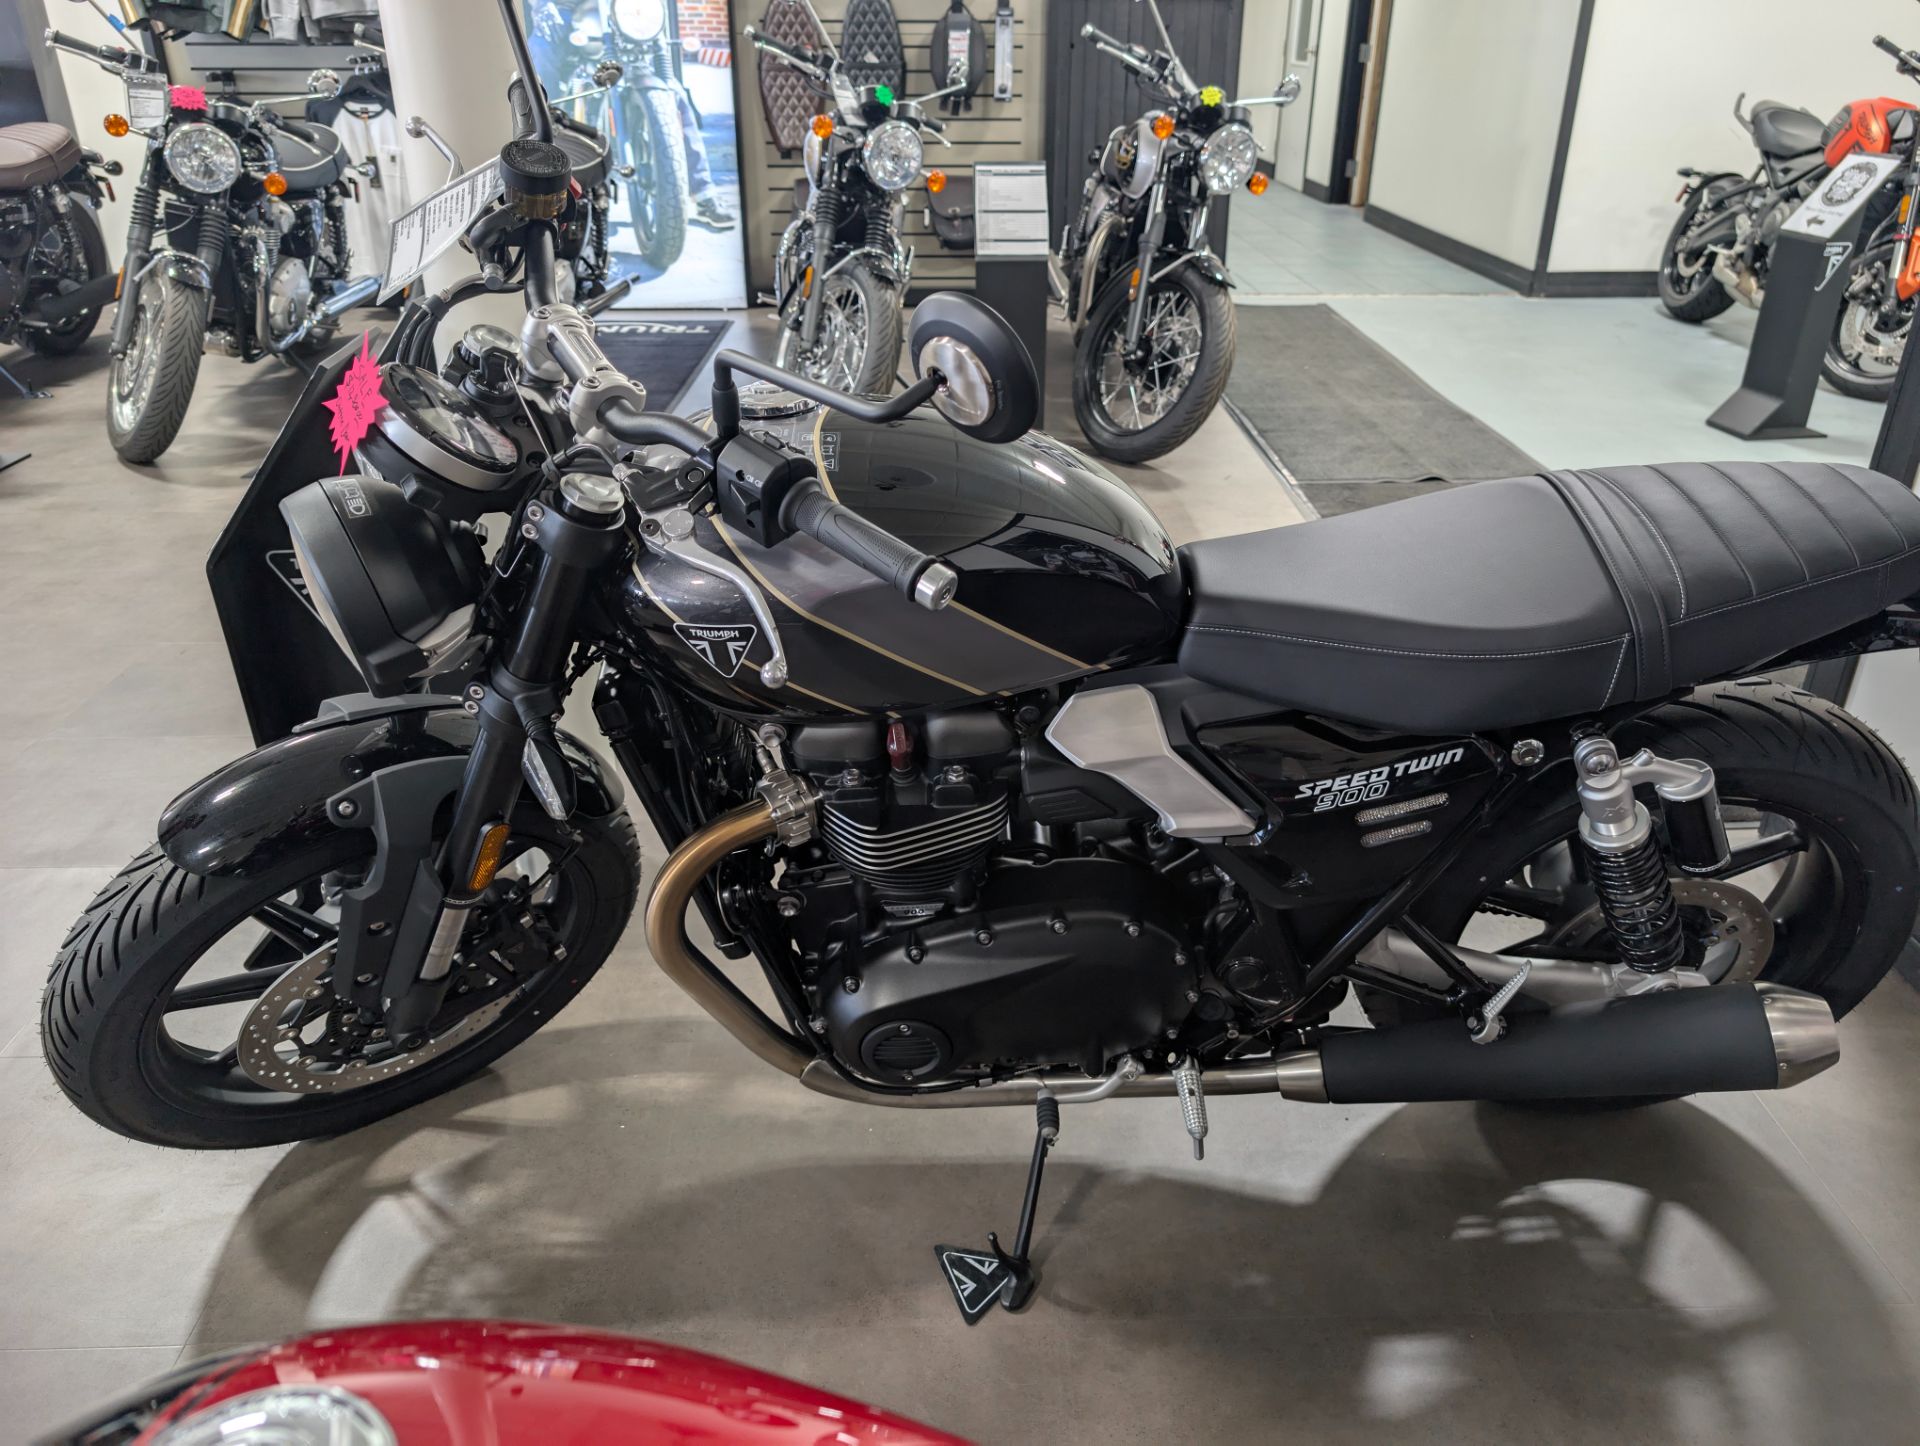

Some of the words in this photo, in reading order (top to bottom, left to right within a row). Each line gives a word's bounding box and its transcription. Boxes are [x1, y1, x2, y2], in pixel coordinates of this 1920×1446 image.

[689, 628, 740, 639] TRIUMPH
[1294, 766, 1391, 799] SPEED
[1394, 747, 1464, 777] TWIN
[1313, 780, 1390, 812] 900
